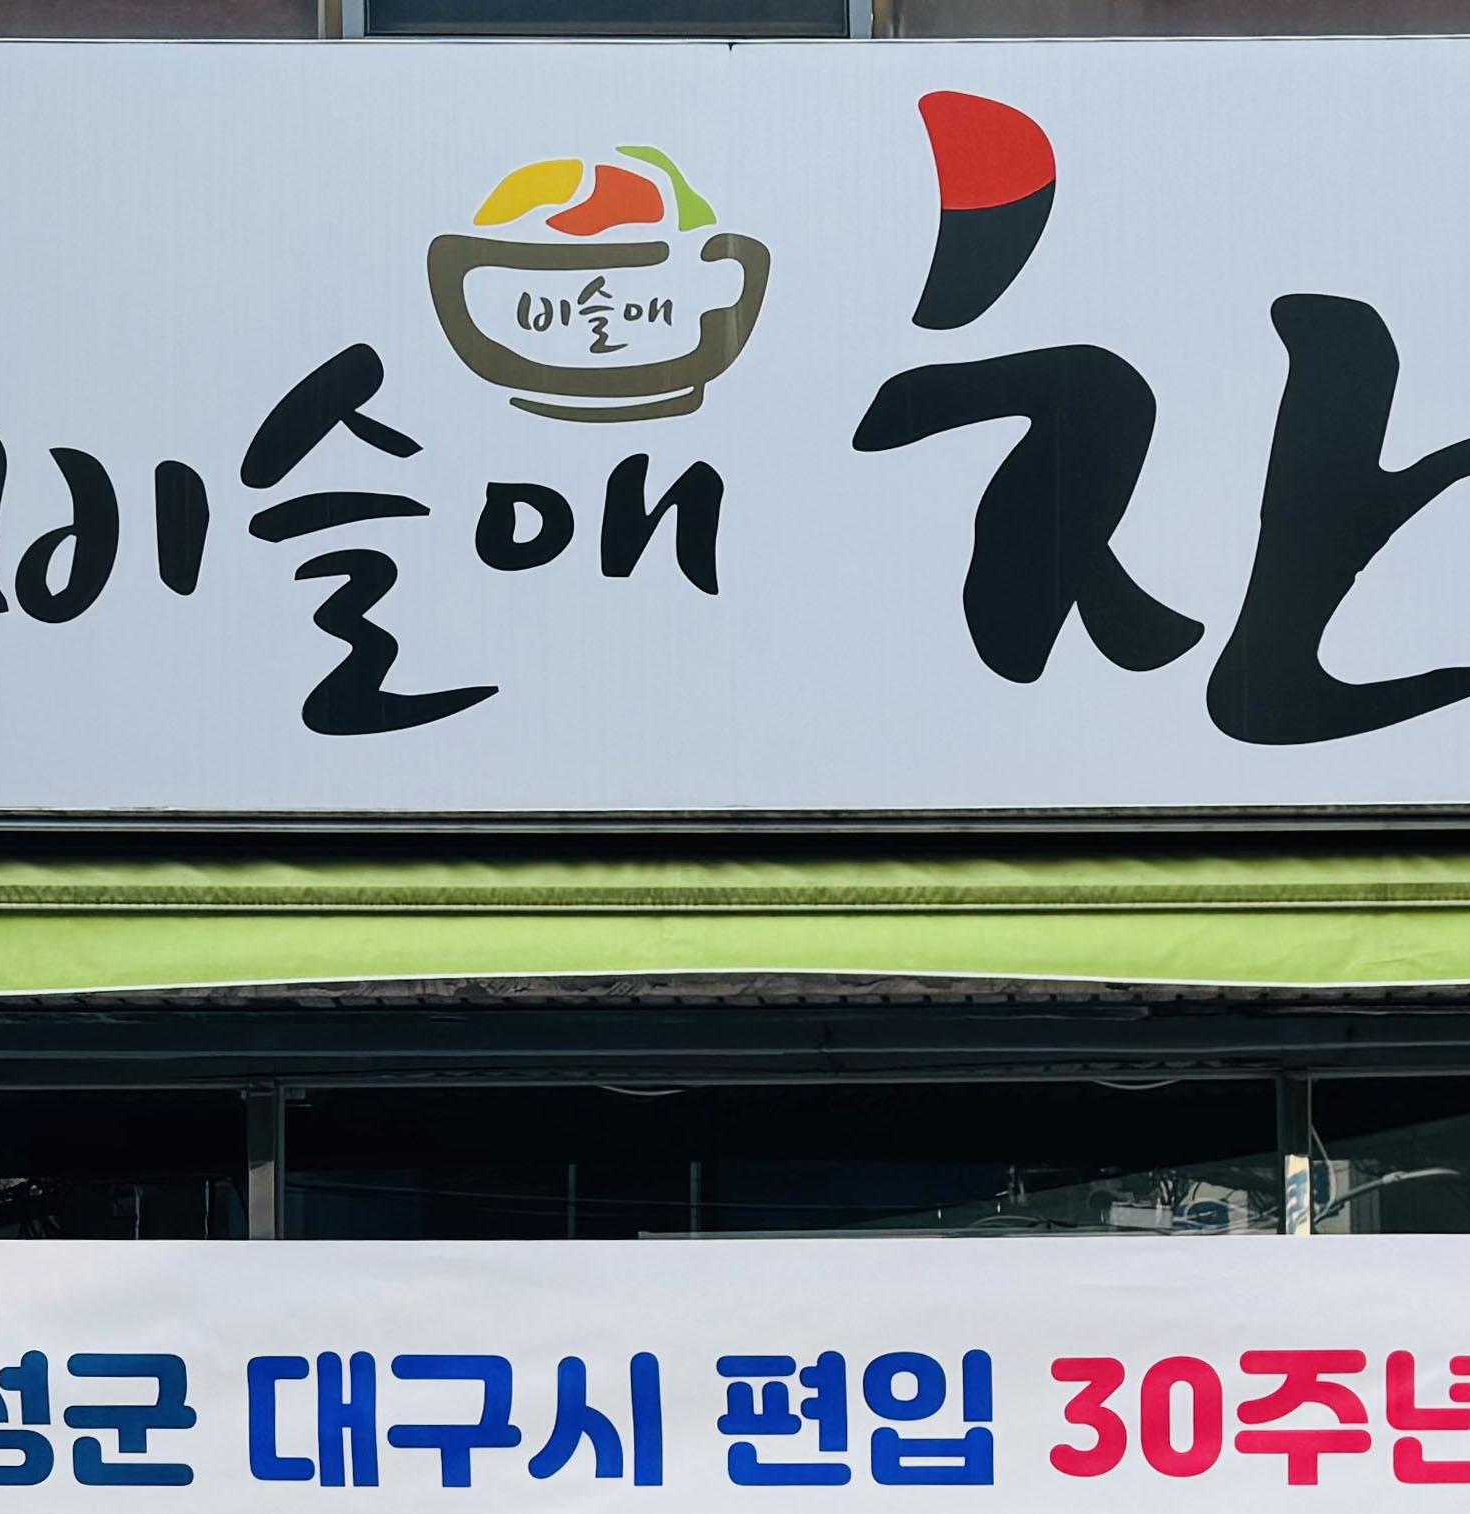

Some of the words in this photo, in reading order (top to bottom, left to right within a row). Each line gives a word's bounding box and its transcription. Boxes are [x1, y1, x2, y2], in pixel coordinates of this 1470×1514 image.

[517, 275, 673, 354] 비슬애
[246, 1350, 663, 1488] 대구시
[716, 1348, 994, 1487] 편입
